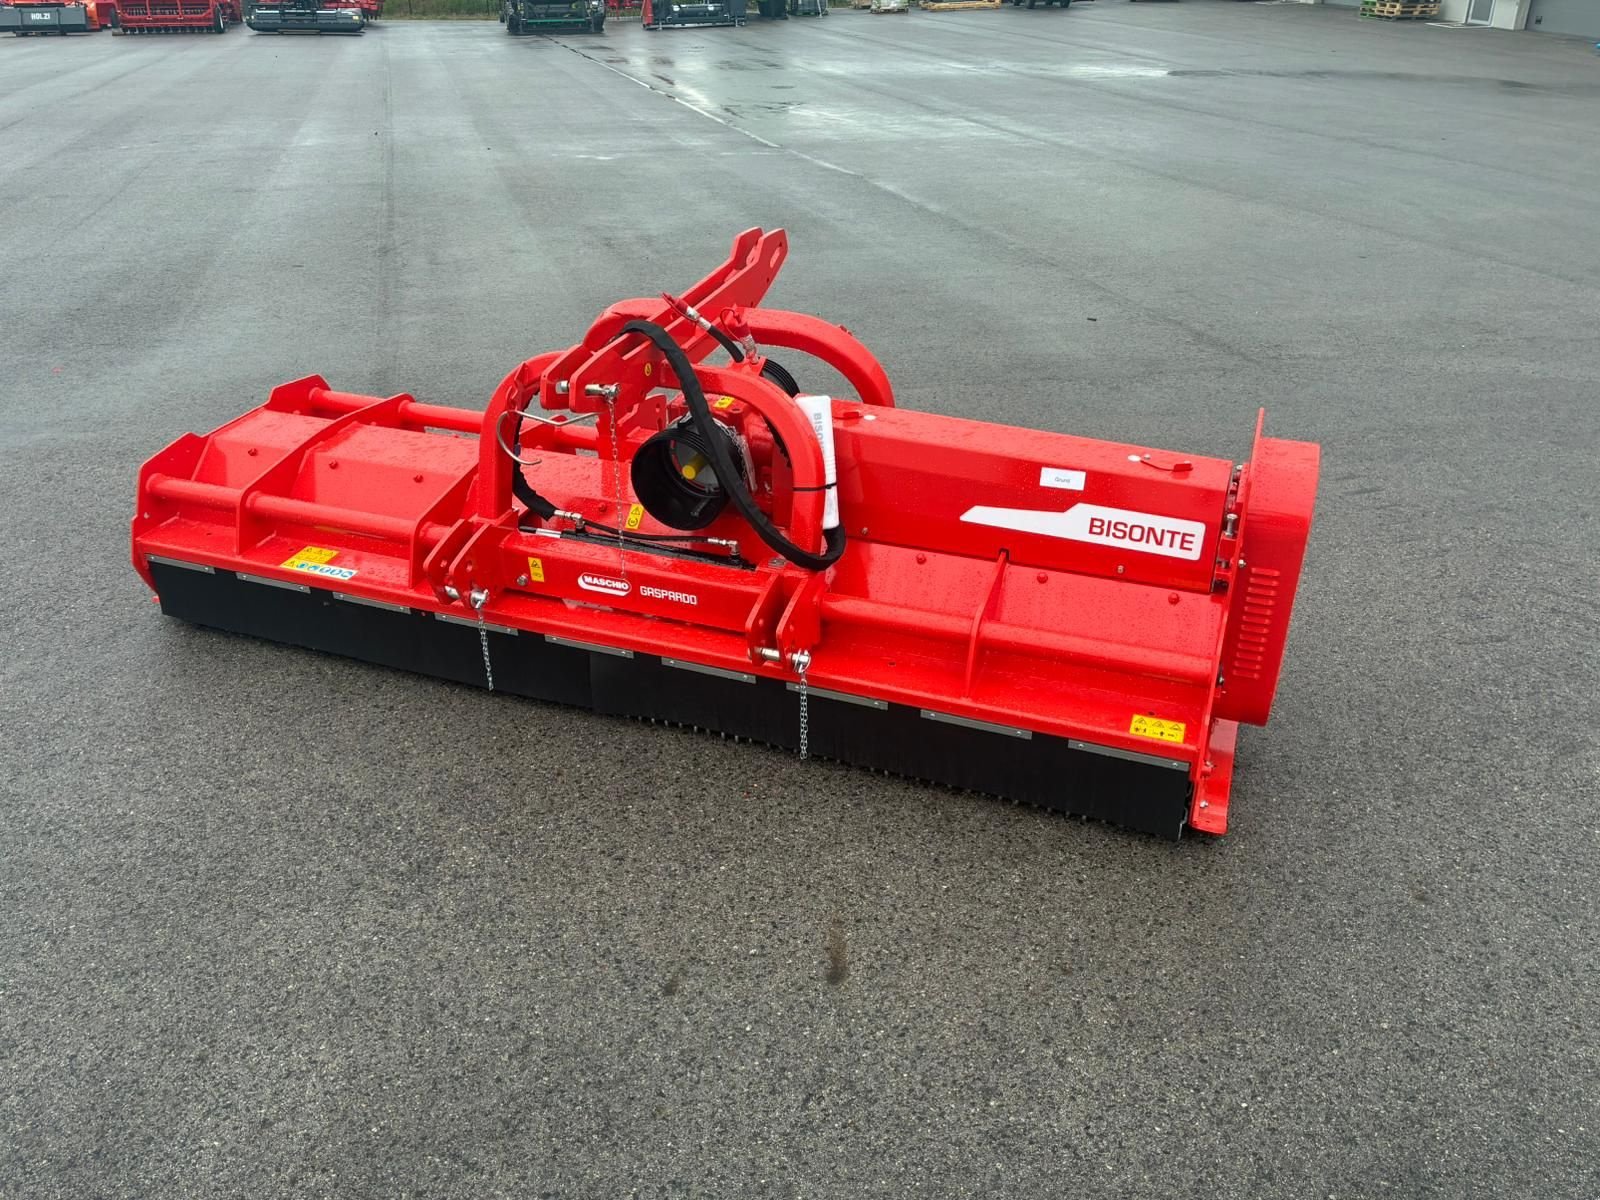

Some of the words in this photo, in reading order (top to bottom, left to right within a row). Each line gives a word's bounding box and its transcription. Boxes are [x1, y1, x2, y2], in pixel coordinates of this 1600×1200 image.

[1088, 517, 1196, 551] BISONTE
[583, 574, 630, 591] MASCHIO
[640, 585, 698, 605] GASPARDO
